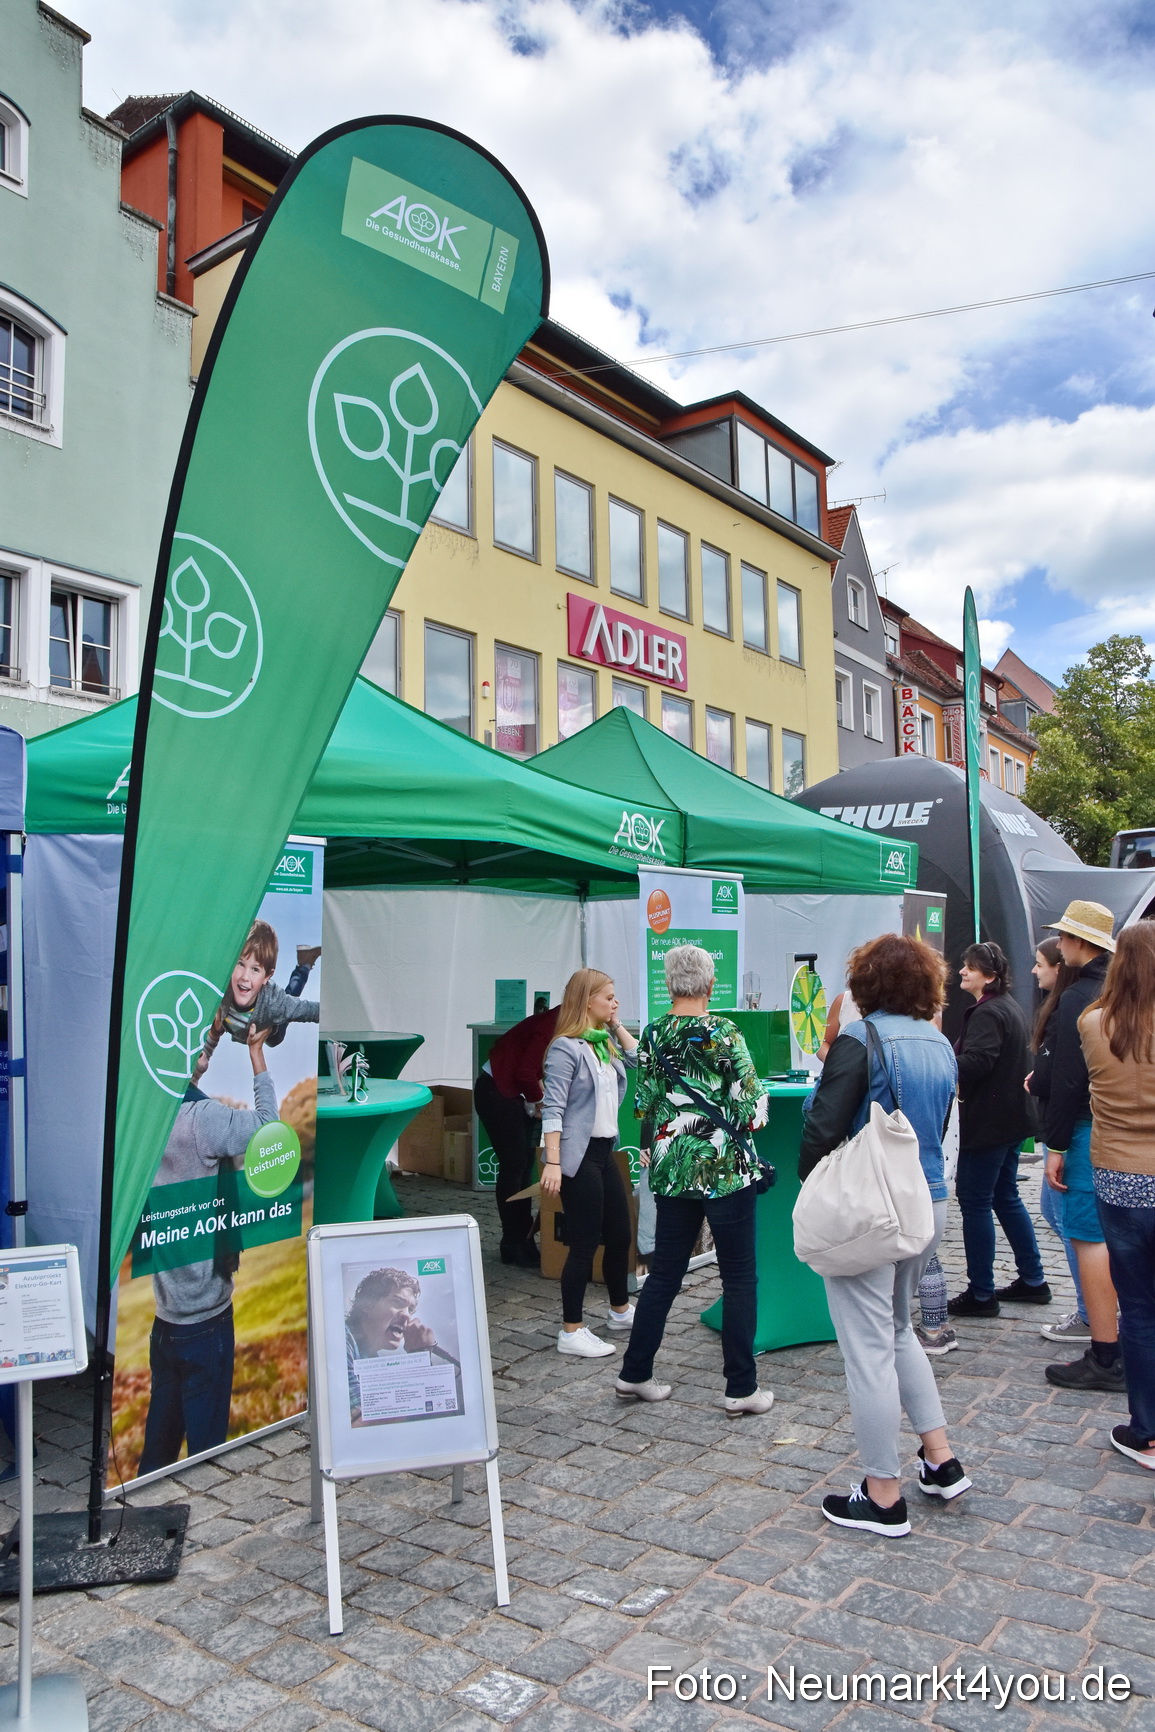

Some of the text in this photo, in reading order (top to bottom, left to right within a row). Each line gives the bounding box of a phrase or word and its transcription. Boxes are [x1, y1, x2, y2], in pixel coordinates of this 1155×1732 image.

[370, 195, 468, 260] AOK
[365, 218, 462, 272] Die Gesundheitskasse.
[492, 246, 509, 292] BAYERN
[582, 603, 685, 683] ADLER
[901, 688, 915, 753] BÄCK
[107, 803, 120, 815] Die
[819, 800, 934, 829] THULE
[897, 818, 925, 826] SWEDEN
[613, 810, 667, 856] AOK
[608, 845, 620, 856] Die
[275, 855, 306, 873] AOK
[885, 850, 906, 871] AOK
[716, 885, 734, 898] AOK
[929, 911, 940, 923] AOK
[651, 937, 659, 946] Der
[671, 937, 681, 946] AOK
[651, 950, 666, 961] Meh
[259, 1141, 283, 1158] Beste
[249, 1150, 296, 1177] Leistungen
[141, 1198, 225, 1223] Leistungsstark vor Ort
[140, 1201, 292, 1250] Meine AOK kann das
[422, 1260, 441, 1270] AOK
[15, 1280, 62, 1290] Elektro-Go-Kart
[23, 1273, 62, 1281] Azubiprojekt
